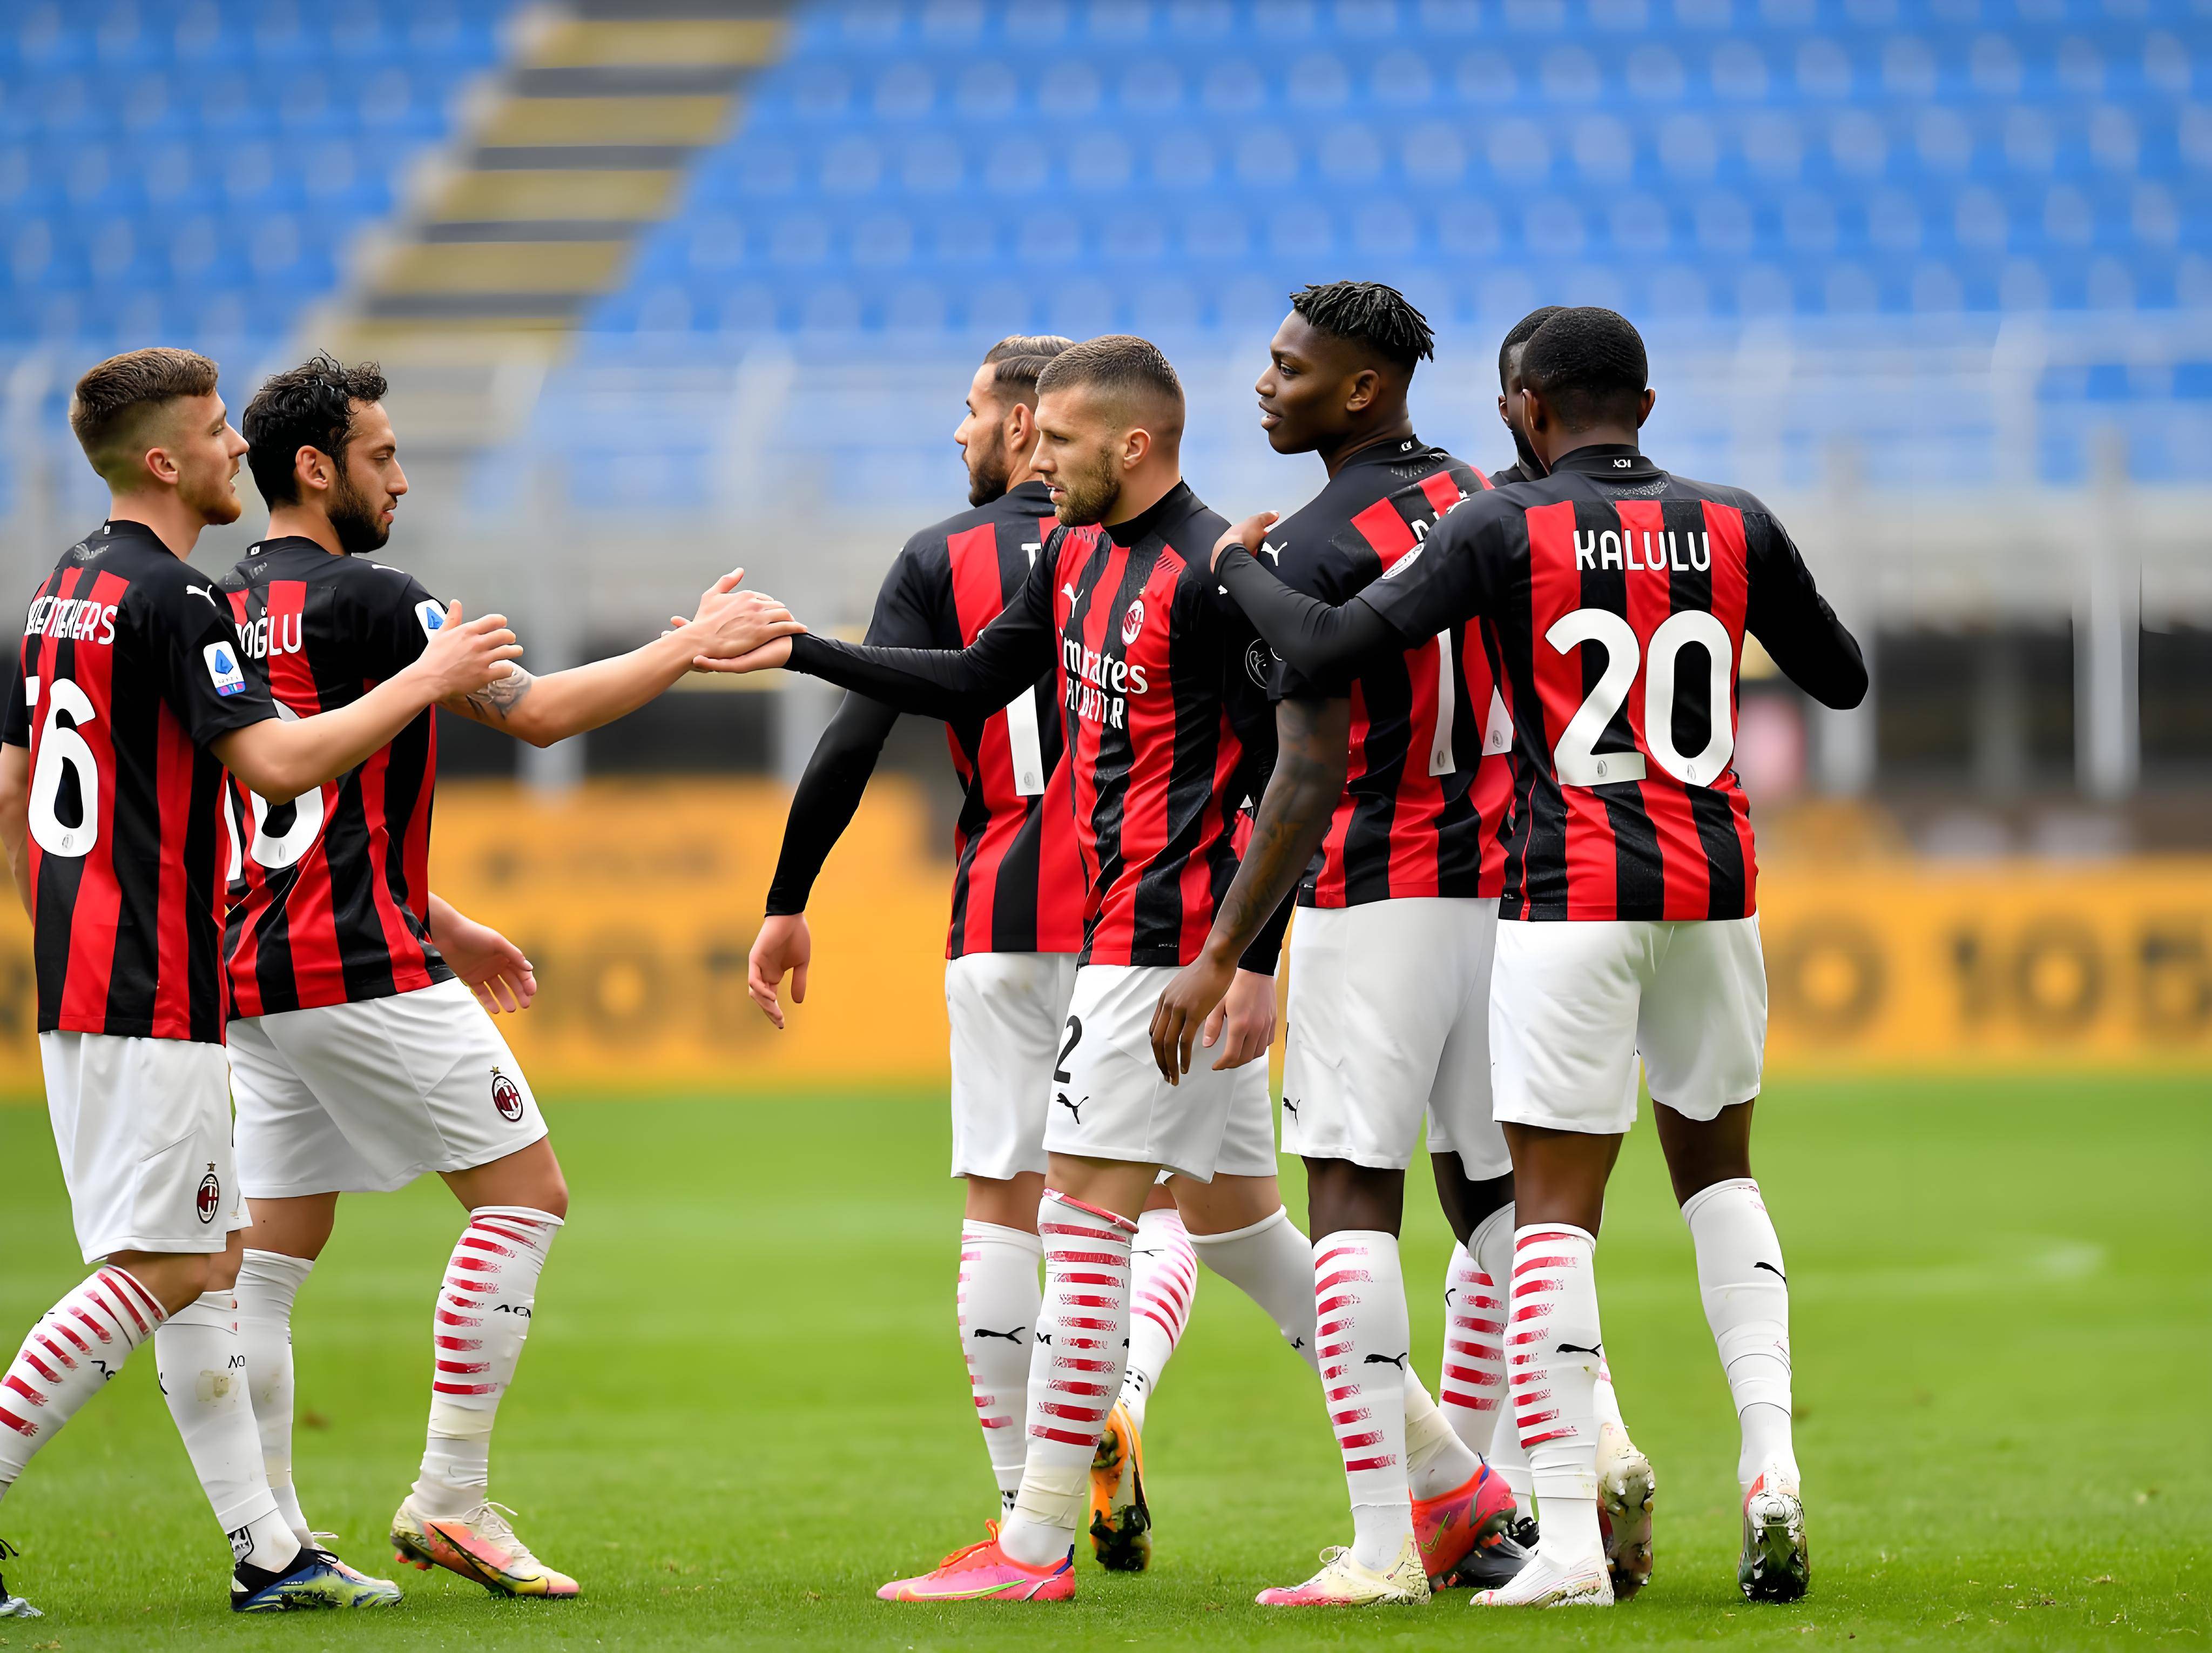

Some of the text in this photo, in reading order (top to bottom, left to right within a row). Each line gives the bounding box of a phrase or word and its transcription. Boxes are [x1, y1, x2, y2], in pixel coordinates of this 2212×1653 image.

[1573, 530, 1711, 572] KALULU
[25, 675, 98, 857] 6
[1545, 608, 1735, 788] 20
